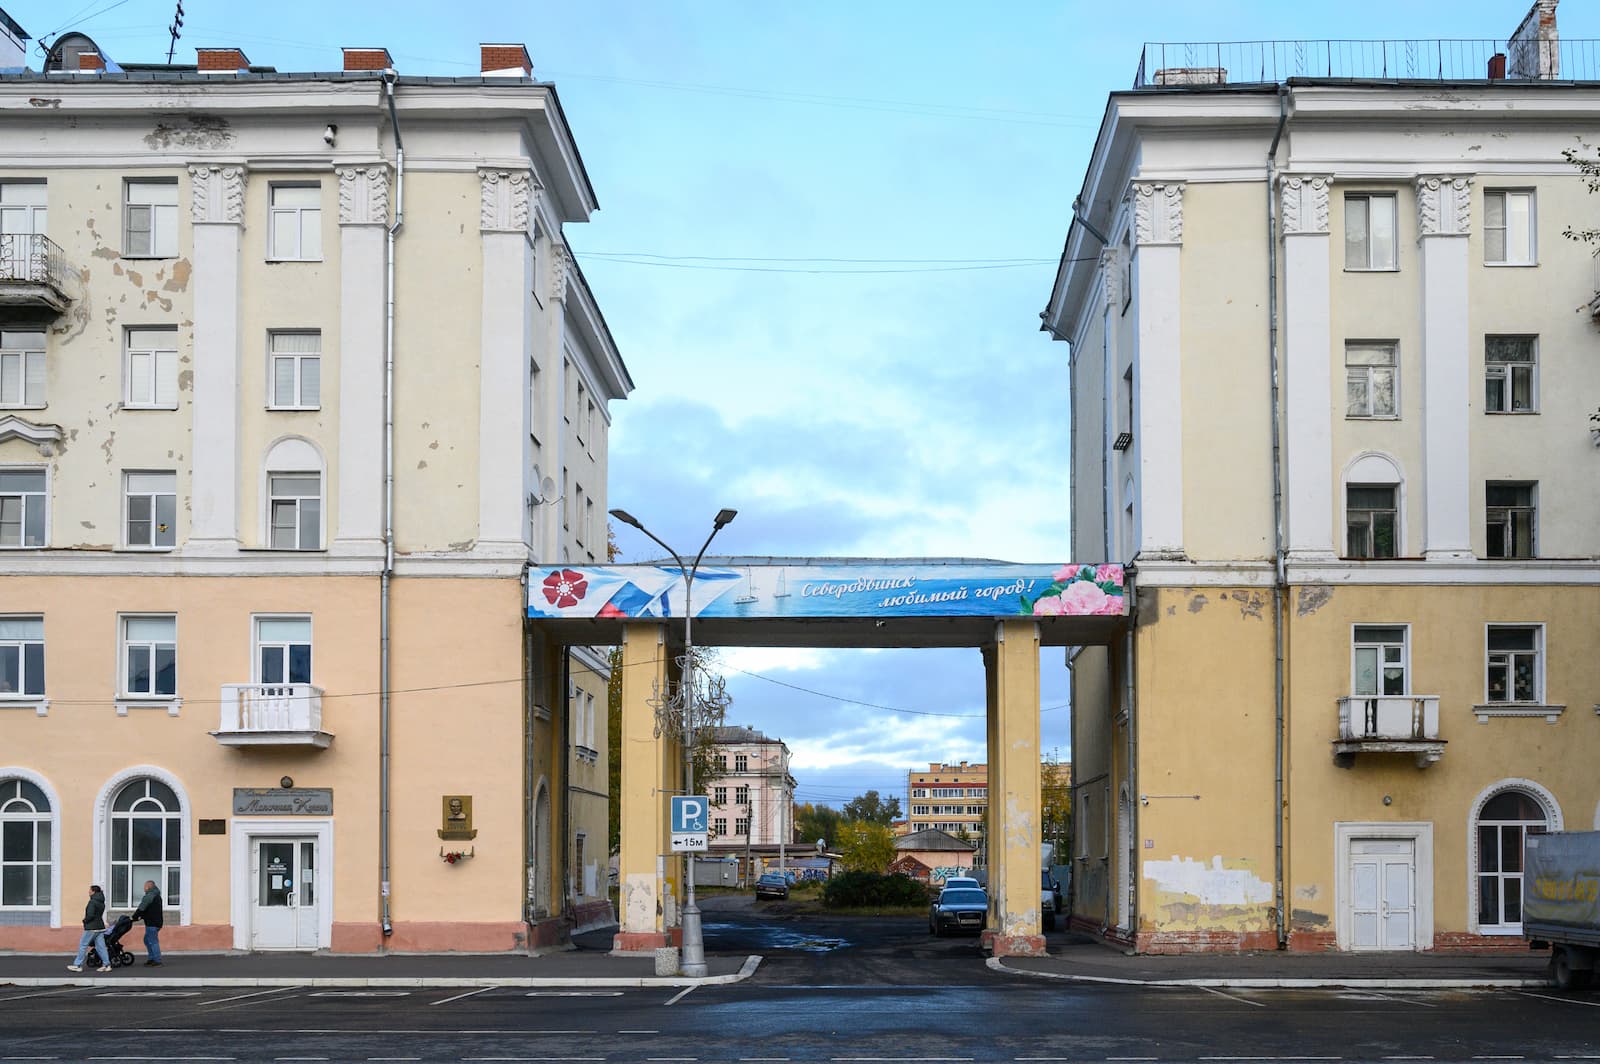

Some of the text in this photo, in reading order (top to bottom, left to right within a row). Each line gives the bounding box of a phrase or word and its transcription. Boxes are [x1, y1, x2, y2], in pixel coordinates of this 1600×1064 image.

[801, 576, 916, 599] Северодвинск
[878, 578, 1035, 608] любимый город!
[681, 800, 701, 828] P
